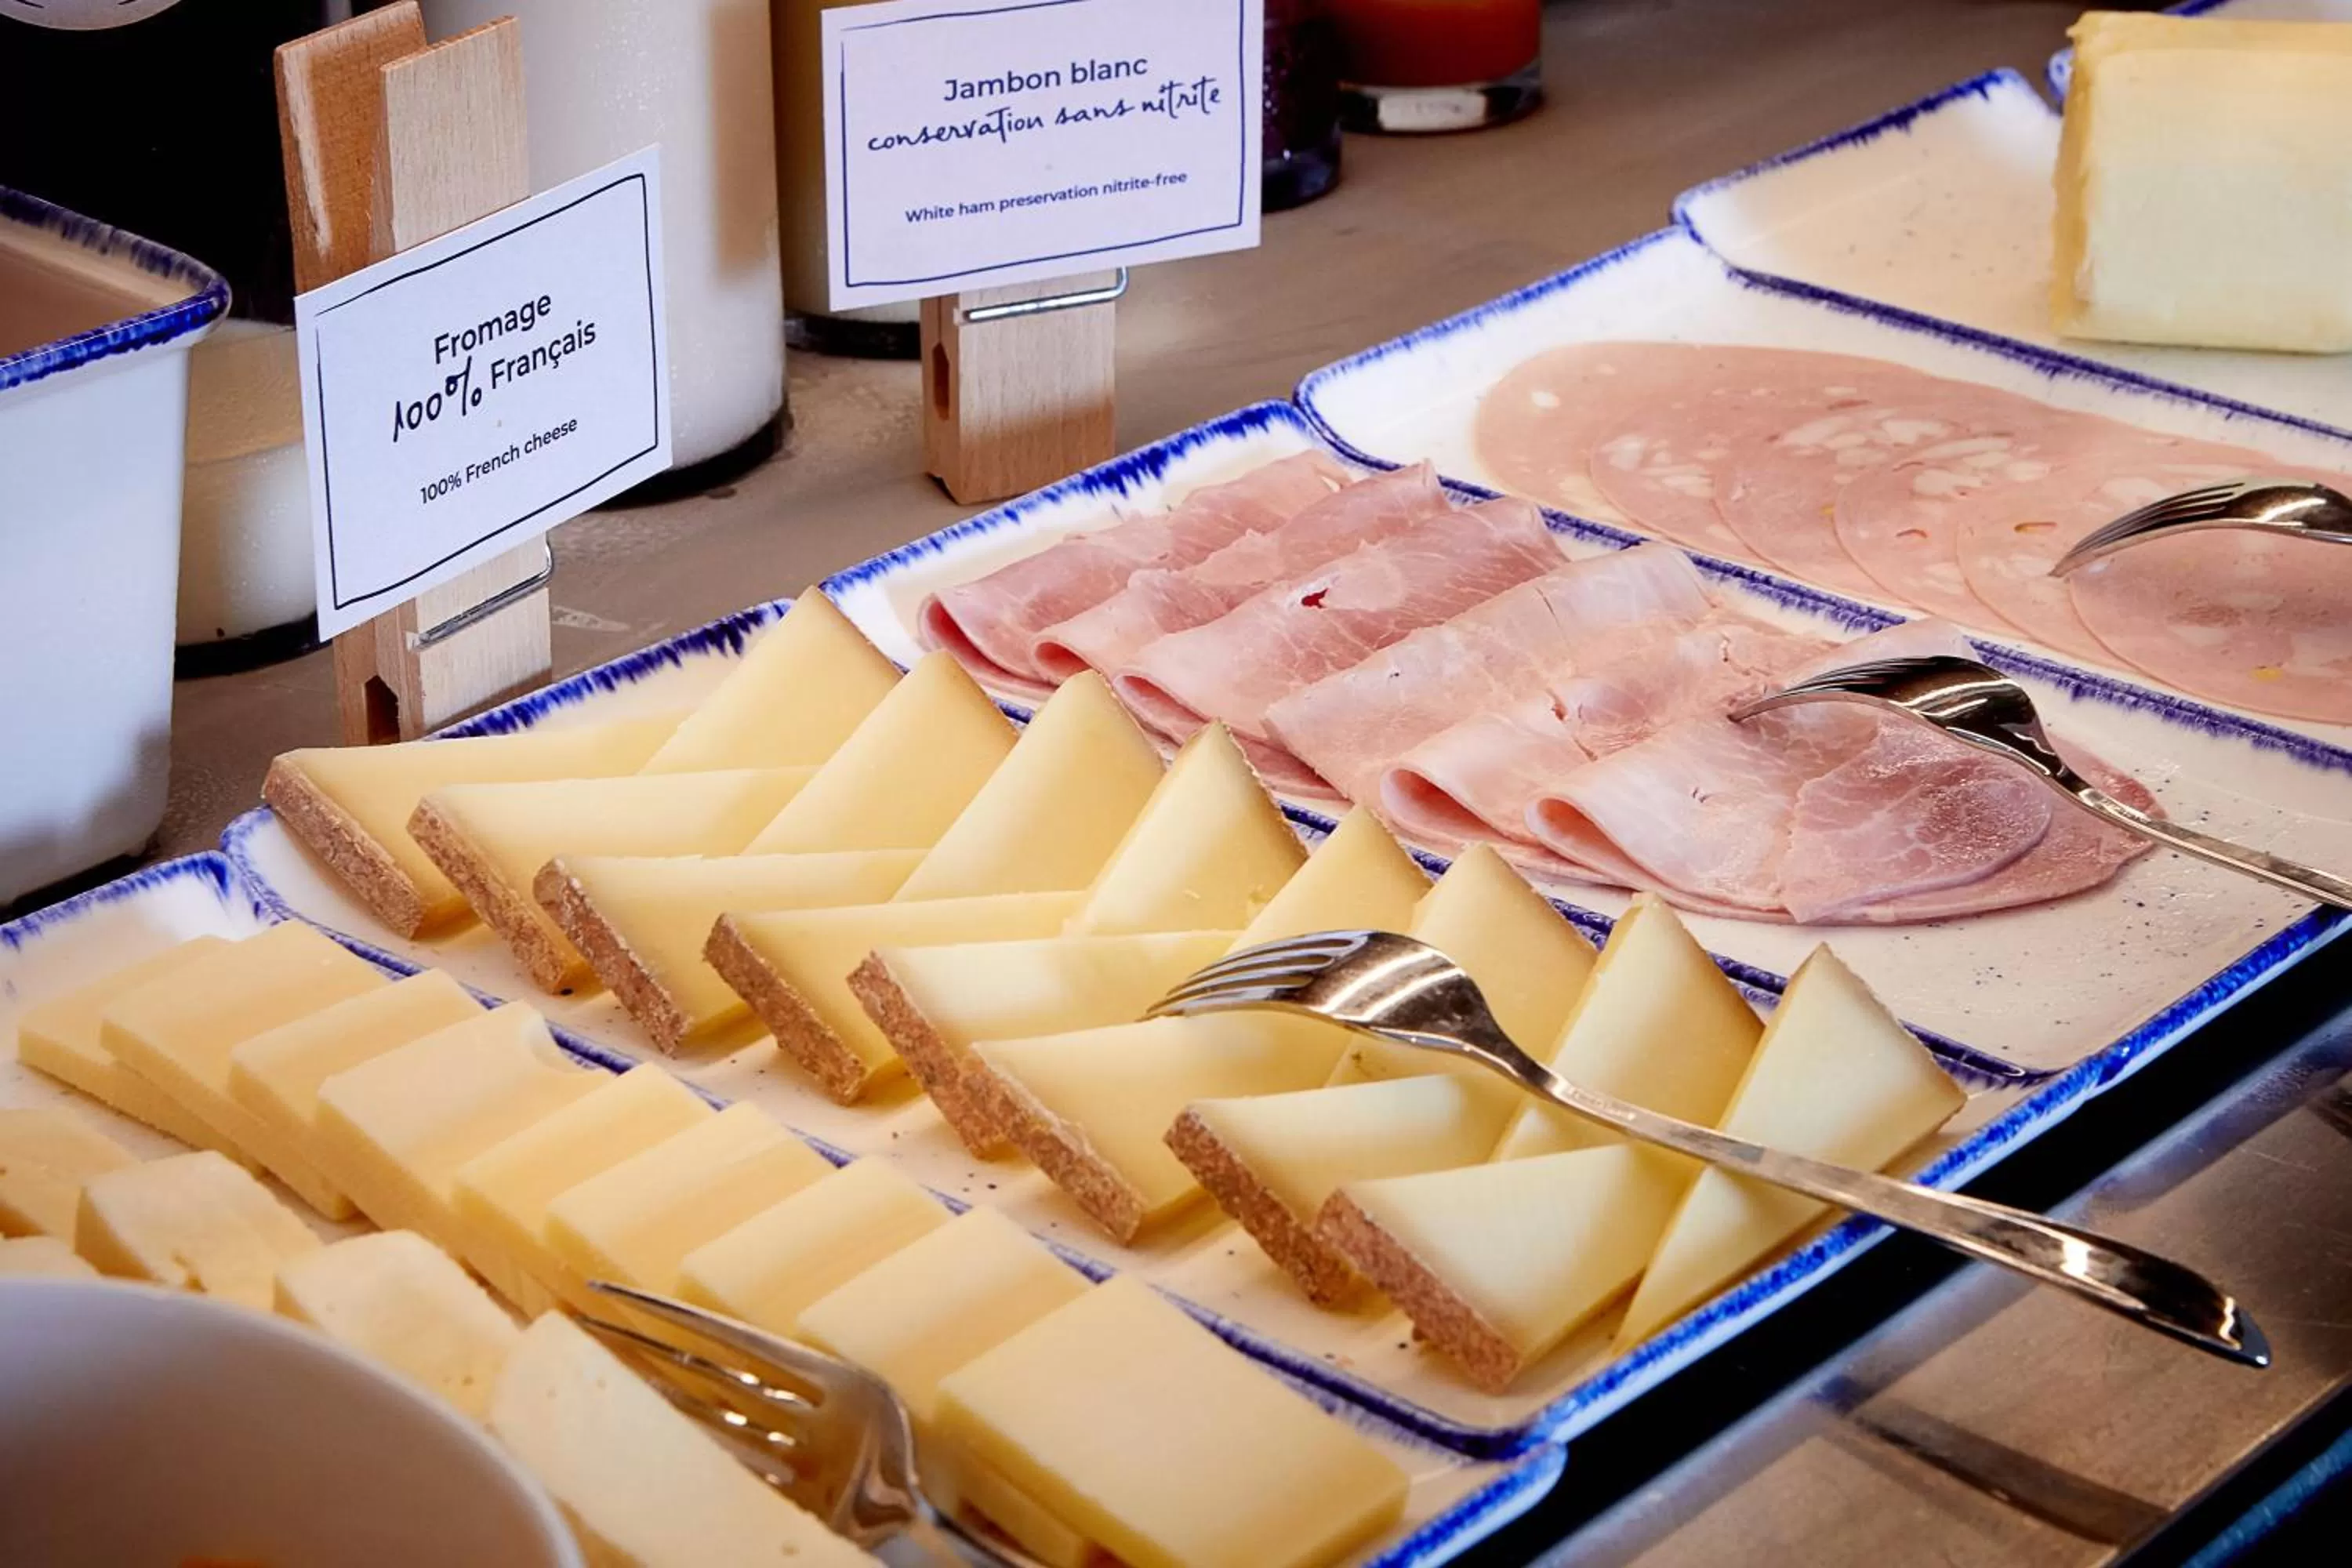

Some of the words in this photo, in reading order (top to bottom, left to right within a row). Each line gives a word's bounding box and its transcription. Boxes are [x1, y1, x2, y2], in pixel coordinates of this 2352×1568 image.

[867, 107, 1044, 152] conservation
[1053, 99, 1135, 125] sans
[1141, 75, 1221, 120] nitrite
[943, 71, 1062, 102] Jambon
[1070, 58, 1148, 84] blanc
[905, 205, 955, 223] White
[958, 202, 996, 216] ham
[999, 187, 1099, 212] preservation
[1102, 173, 1188, 197] nitrite-free
[434, 293, 552, 365] Fromage
[392, 354, 483, 444] 100%
[489, 319, 597, 390] Français
[419, 472, 463, 505] 100%
[465, 445, 521, 484] French
[523, 418, 579, 455] cheese
